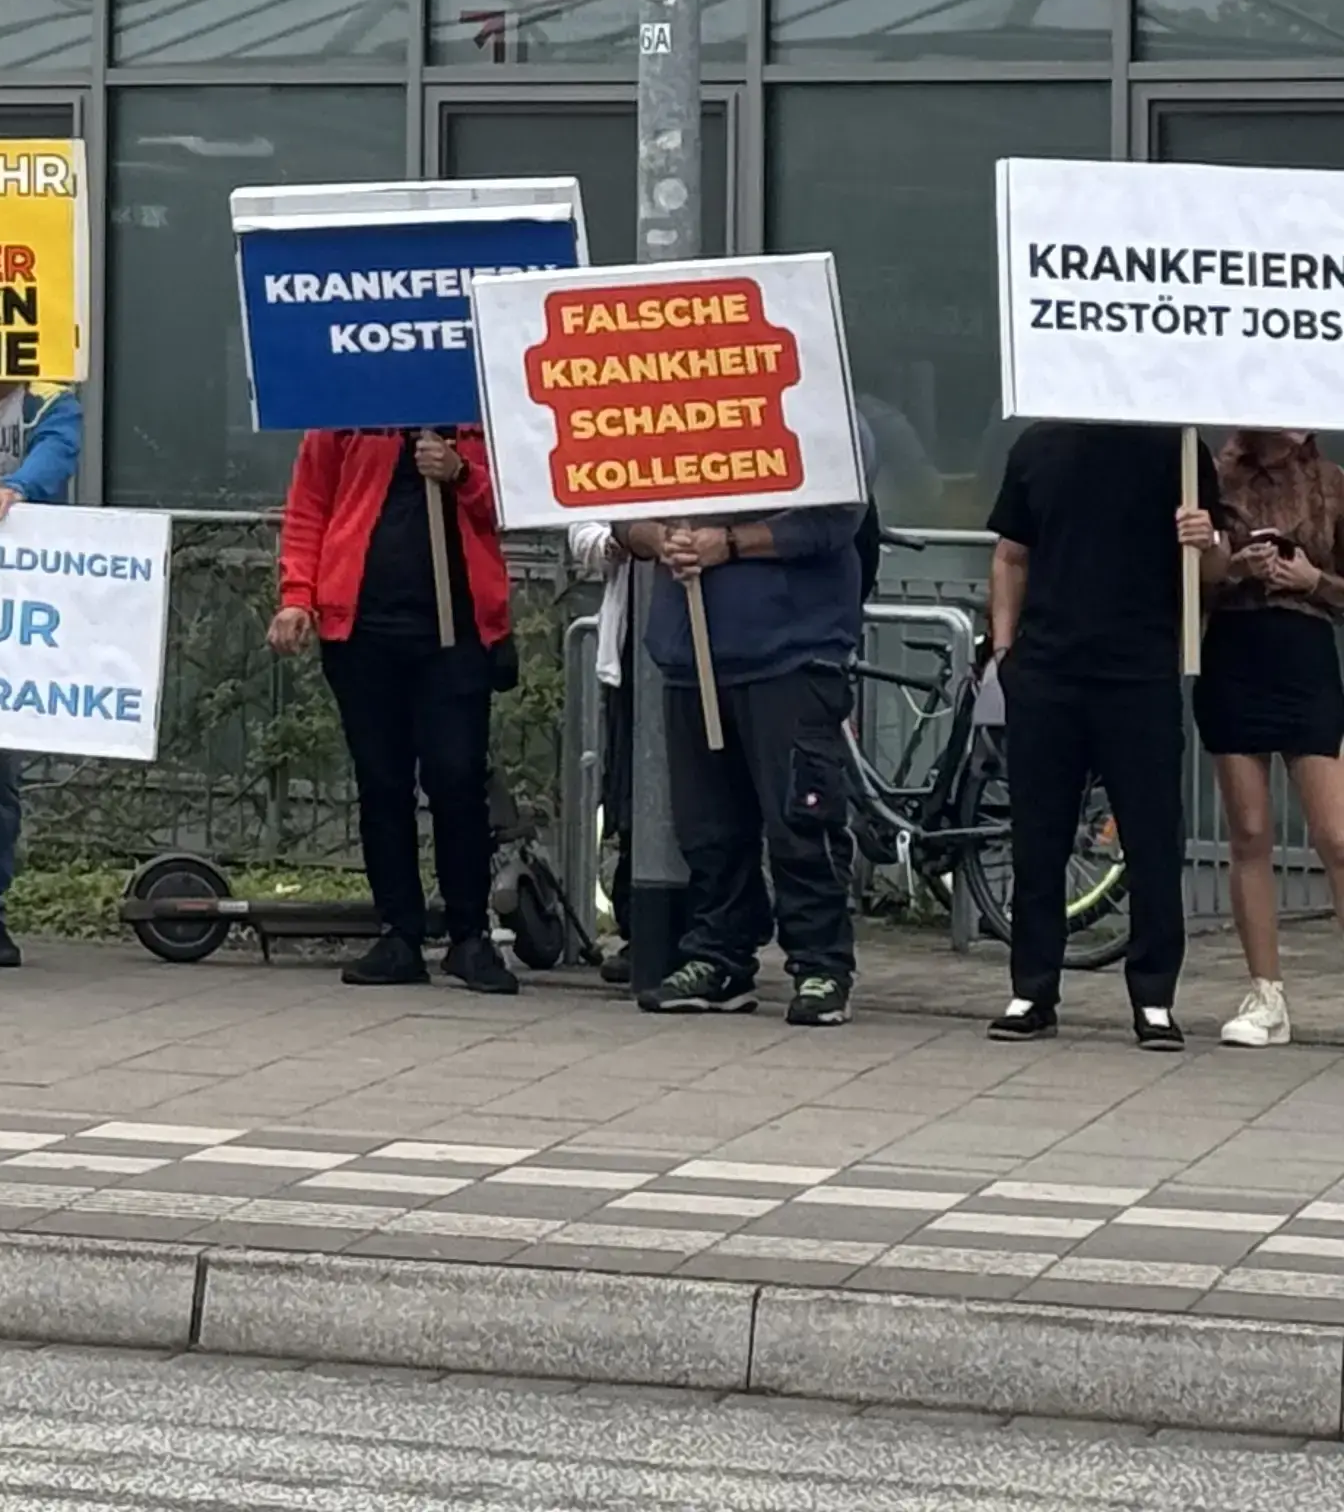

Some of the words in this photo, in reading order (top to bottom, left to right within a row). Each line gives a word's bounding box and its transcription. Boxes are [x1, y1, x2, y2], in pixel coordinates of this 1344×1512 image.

[1028, 242, 1344, 291] KRANKFEIERN
[561, 293, 750, 335] FALSCHE
[1029, 294, 1231, 337] ZERSTÖRT
[1242, 306, 1344, 342] JOBS
[540, 344, 783, 389] KRANKHEIT
[570, 396, 768, 440] SCHADET
[565, 448, 788, 492] KOLLEGEN
